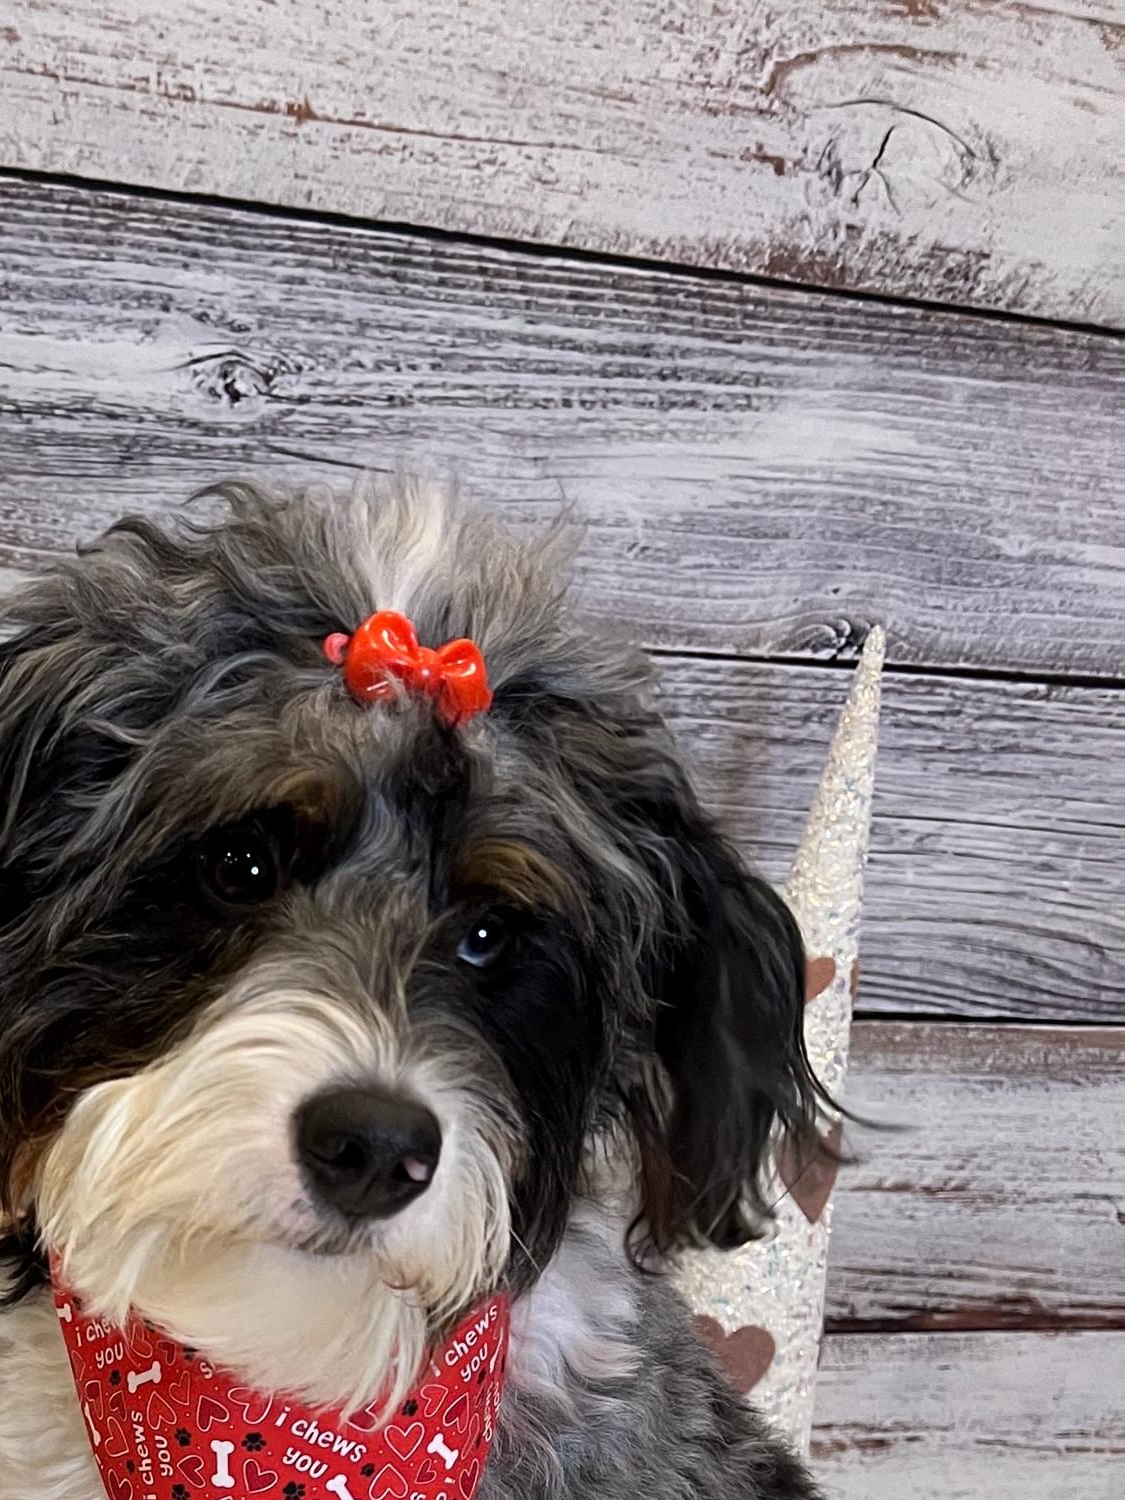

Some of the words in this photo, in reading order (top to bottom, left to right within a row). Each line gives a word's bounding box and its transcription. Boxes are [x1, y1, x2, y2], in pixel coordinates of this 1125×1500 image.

[75, 1326, 82, 1347] i
[95, 1342, 124, 1369] you
[445, 1305, 497, 1366] chews
[460, 1343, 487, 1382] you
[131, 1410, 154, 1485] chews
[275, 1407, 291, 1427] i
[291, 1419, 367, 1463] chews
[155, 1435, 174, 1476] you
[283, 1447, 328, 1479] you
